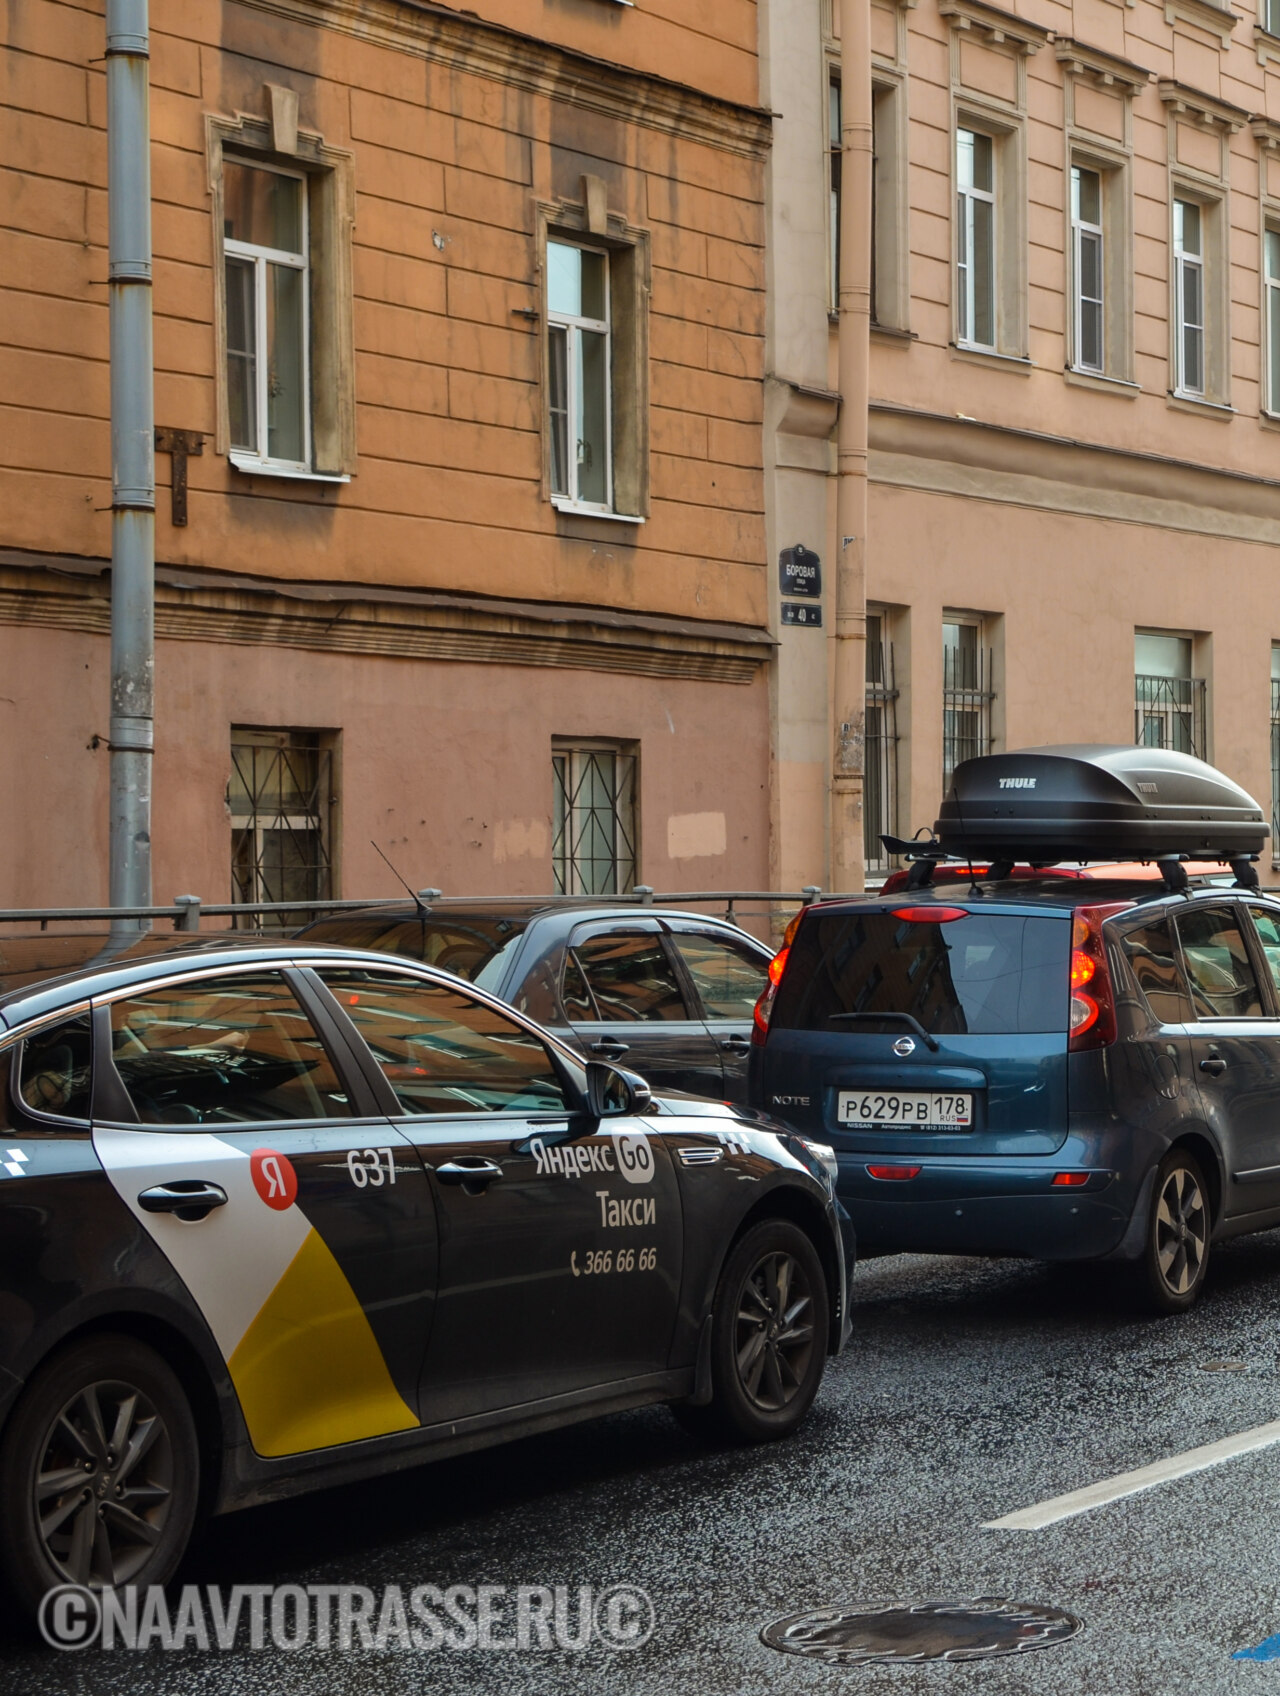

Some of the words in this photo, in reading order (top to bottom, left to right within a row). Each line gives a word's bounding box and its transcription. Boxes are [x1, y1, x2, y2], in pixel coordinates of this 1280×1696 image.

[786, 564, 816, 578] БОРОВАЯ
[798, 608, 806, 622] 40
[999, 778, 1037, 789] THULE
[772, 1095, 811, 1106] NOTE
[846, 1096, 928, 1120] Р629РВ
[934, 1097, 965, 1115] 178
[940, 1114, 956, 1122] RUS
[347, 1147, 396, 1188] 637
[530, 1138, 615, 1178] Яндекс
[619, 1136, 650, 1171] Go
[261, 1156, 287, 1198] Я
[595, 1190, 656, 1228] Такси
[584, 1250, 612, 1275] 366
[616, 1248, 635, 1272] 66
[638, 1247, 657, 1270] 66
